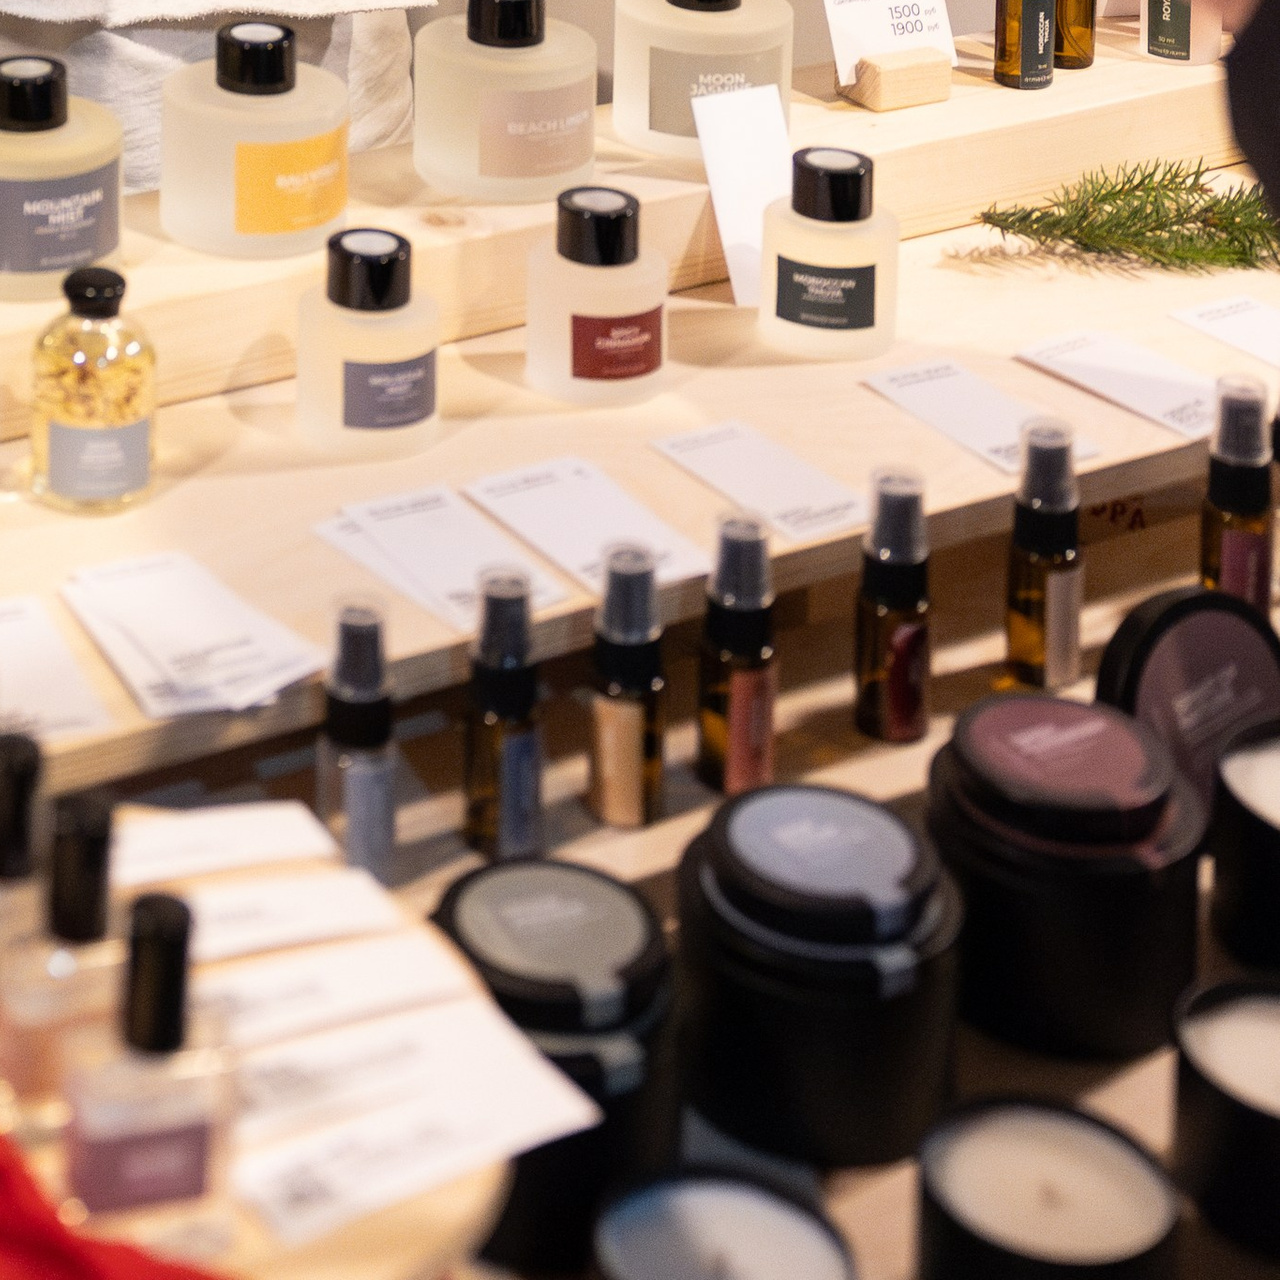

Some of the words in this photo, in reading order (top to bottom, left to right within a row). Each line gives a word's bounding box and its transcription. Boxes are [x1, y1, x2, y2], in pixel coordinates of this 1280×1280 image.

[888, 3, 921, 20] 1500
[890, 19, 924, 36] 1900
[699, 72, 745, 85] MOON
[23, 187, 103, 216] MOUNTAIN
